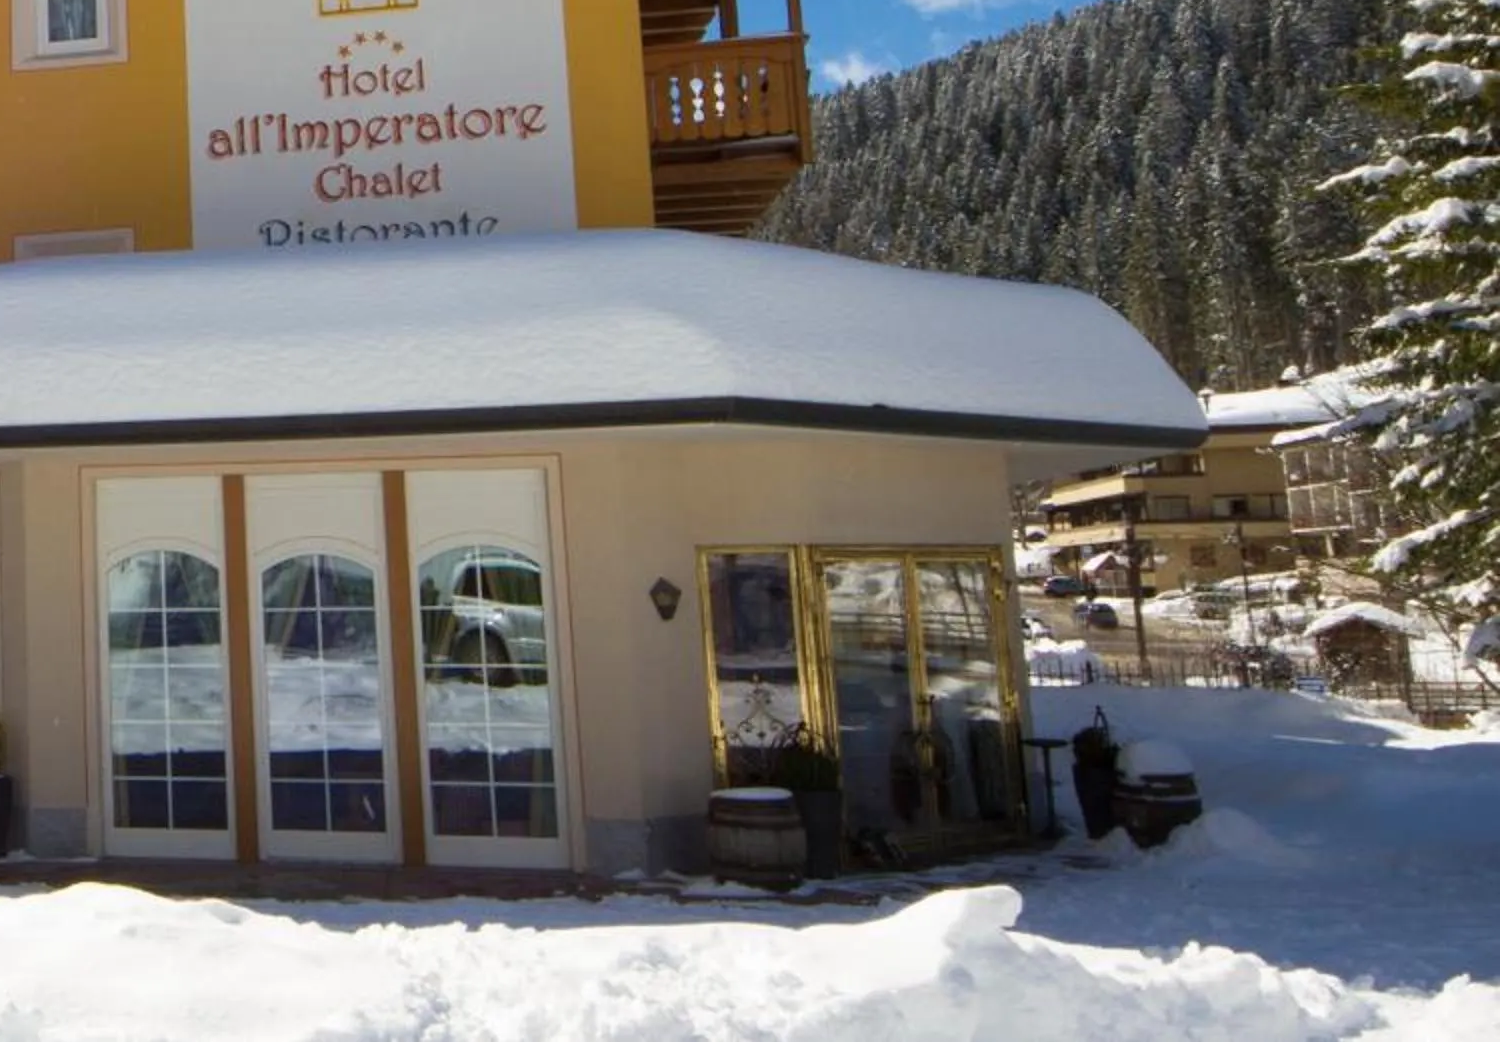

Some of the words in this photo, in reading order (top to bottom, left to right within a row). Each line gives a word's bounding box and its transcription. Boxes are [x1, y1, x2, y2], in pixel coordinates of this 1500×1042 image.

[319, 58, 426, 98] Hotel
[206, 103, 548, 159] all'Imperatore
[314, 162, 443, 202] Chalet
